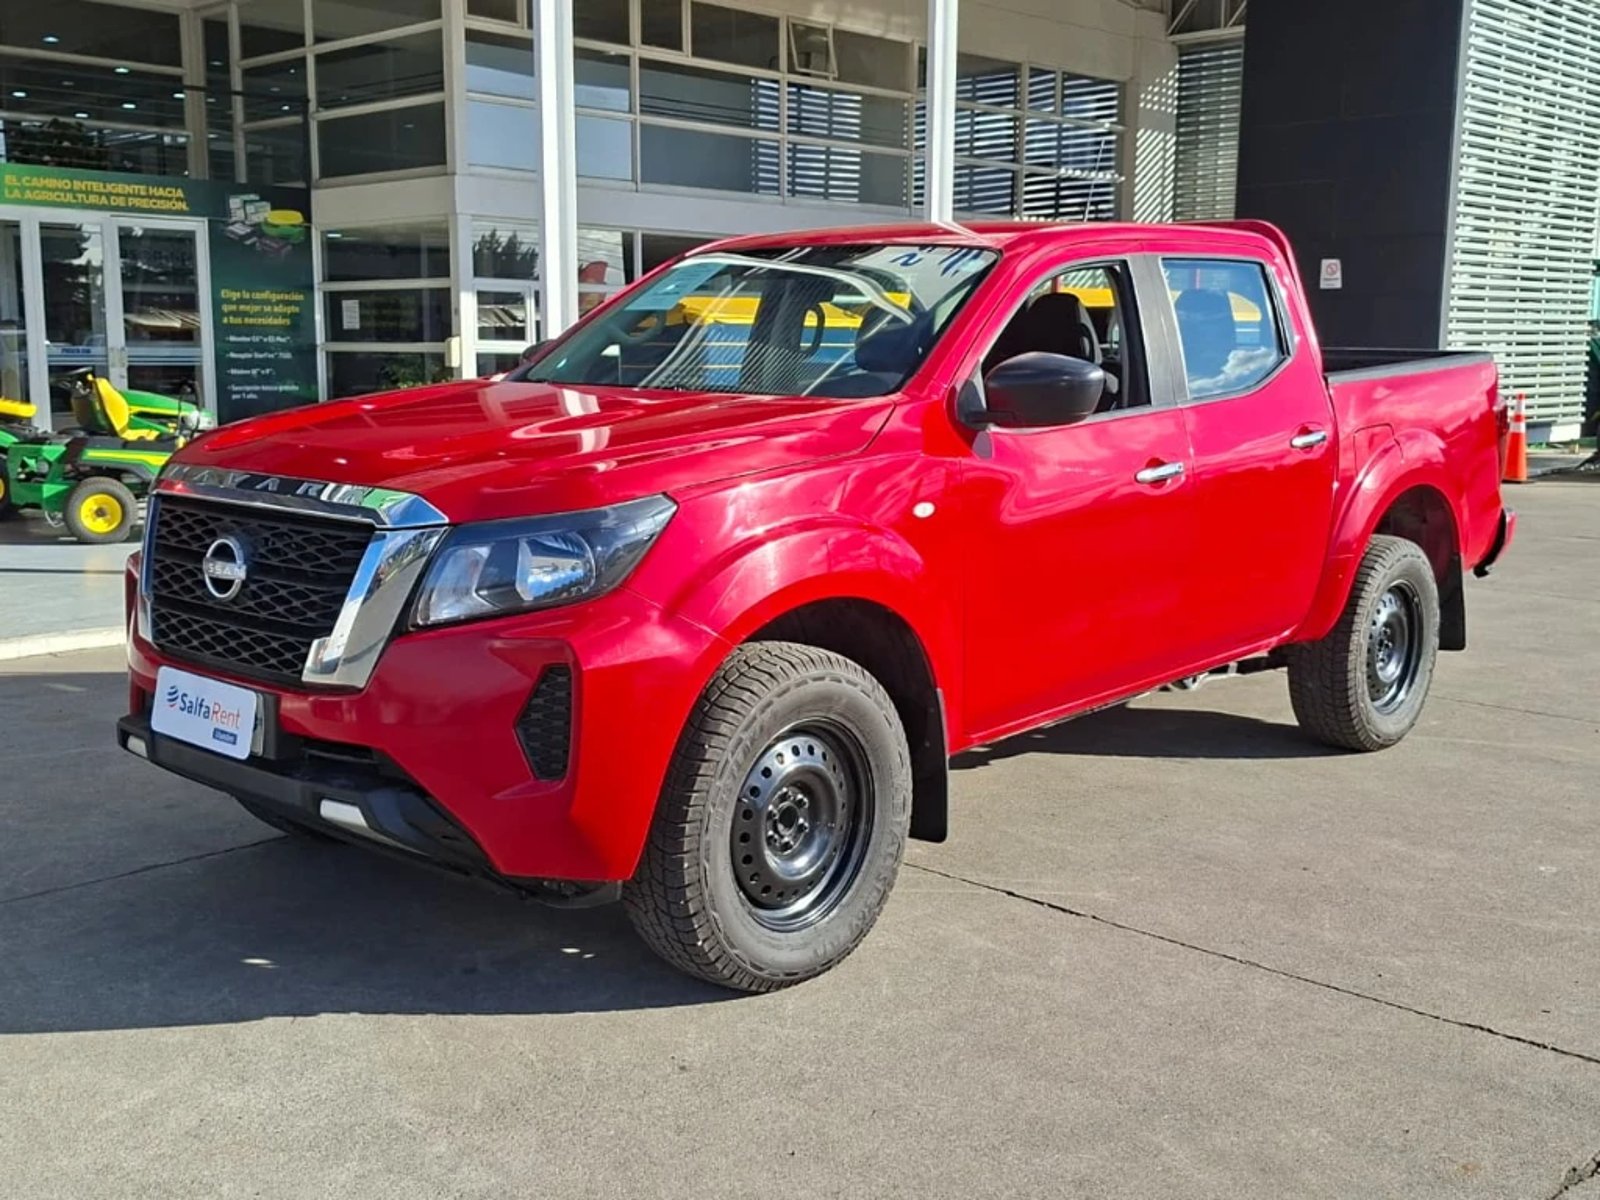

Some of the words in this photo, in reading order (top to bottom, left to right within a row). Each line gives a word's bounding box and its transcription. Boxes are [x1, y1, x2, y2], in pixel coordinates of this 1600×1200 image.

[4, 187, 20, 199] LA
[24, 190, 108, 206] AGRICULTURA
[110, 196, 127, 207] DE
[5, 174, 20, 186] EL
[22, 176, 71, 189] CAMINO
[73, 180, 148, 196] INTELIGENTE
[149, 185, 184, 198] HACIA
[204, 560, 246, 578] SSAN
[179, 692, 241, 729] SalfaRent
